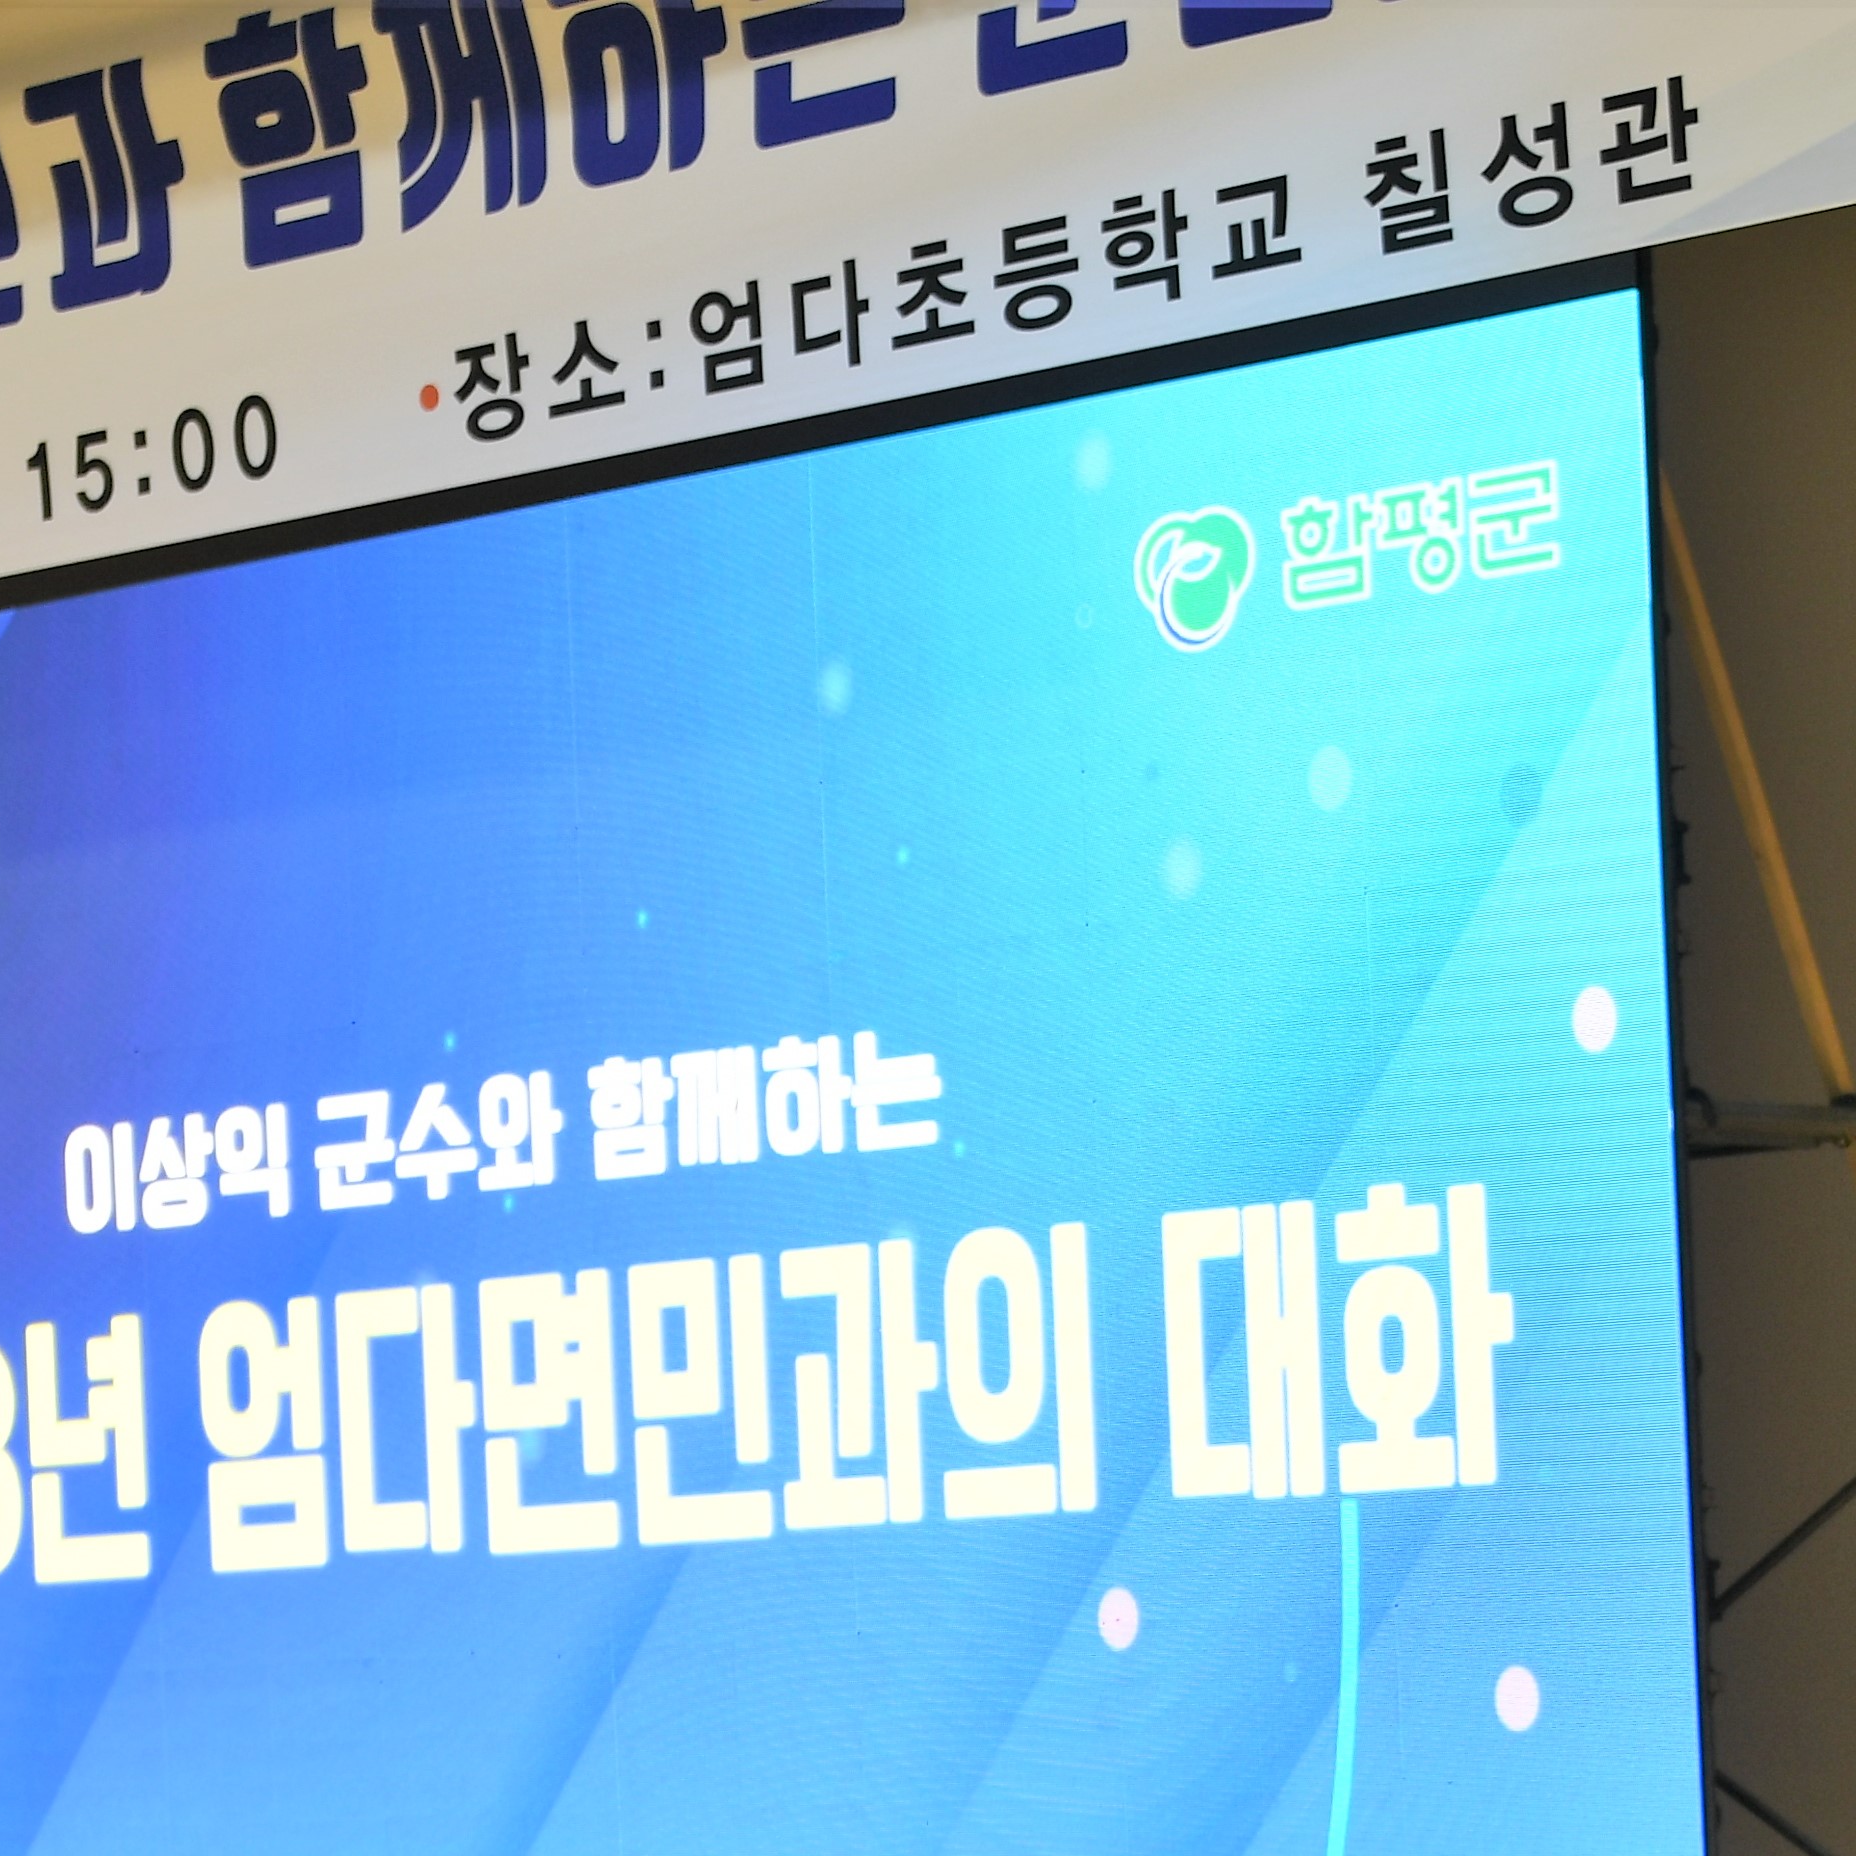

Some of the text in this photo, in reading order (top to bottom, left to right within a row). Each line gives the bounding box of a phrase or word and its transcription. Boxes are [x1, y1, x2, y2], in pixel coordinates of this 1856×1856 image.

[452, 75, 1700, 443] 장소:엄다초등학교 칠성관
[25, 394, 278, 522] 15:00
[1280, 457, 1561, 612] 함평군
[62, 1030, 943, 1236] 이상익 군수와 함께하는
[196, 1216, 1100, 1578] 엄다면민과의
[1162, 1180, 1517, 1504] 대화
